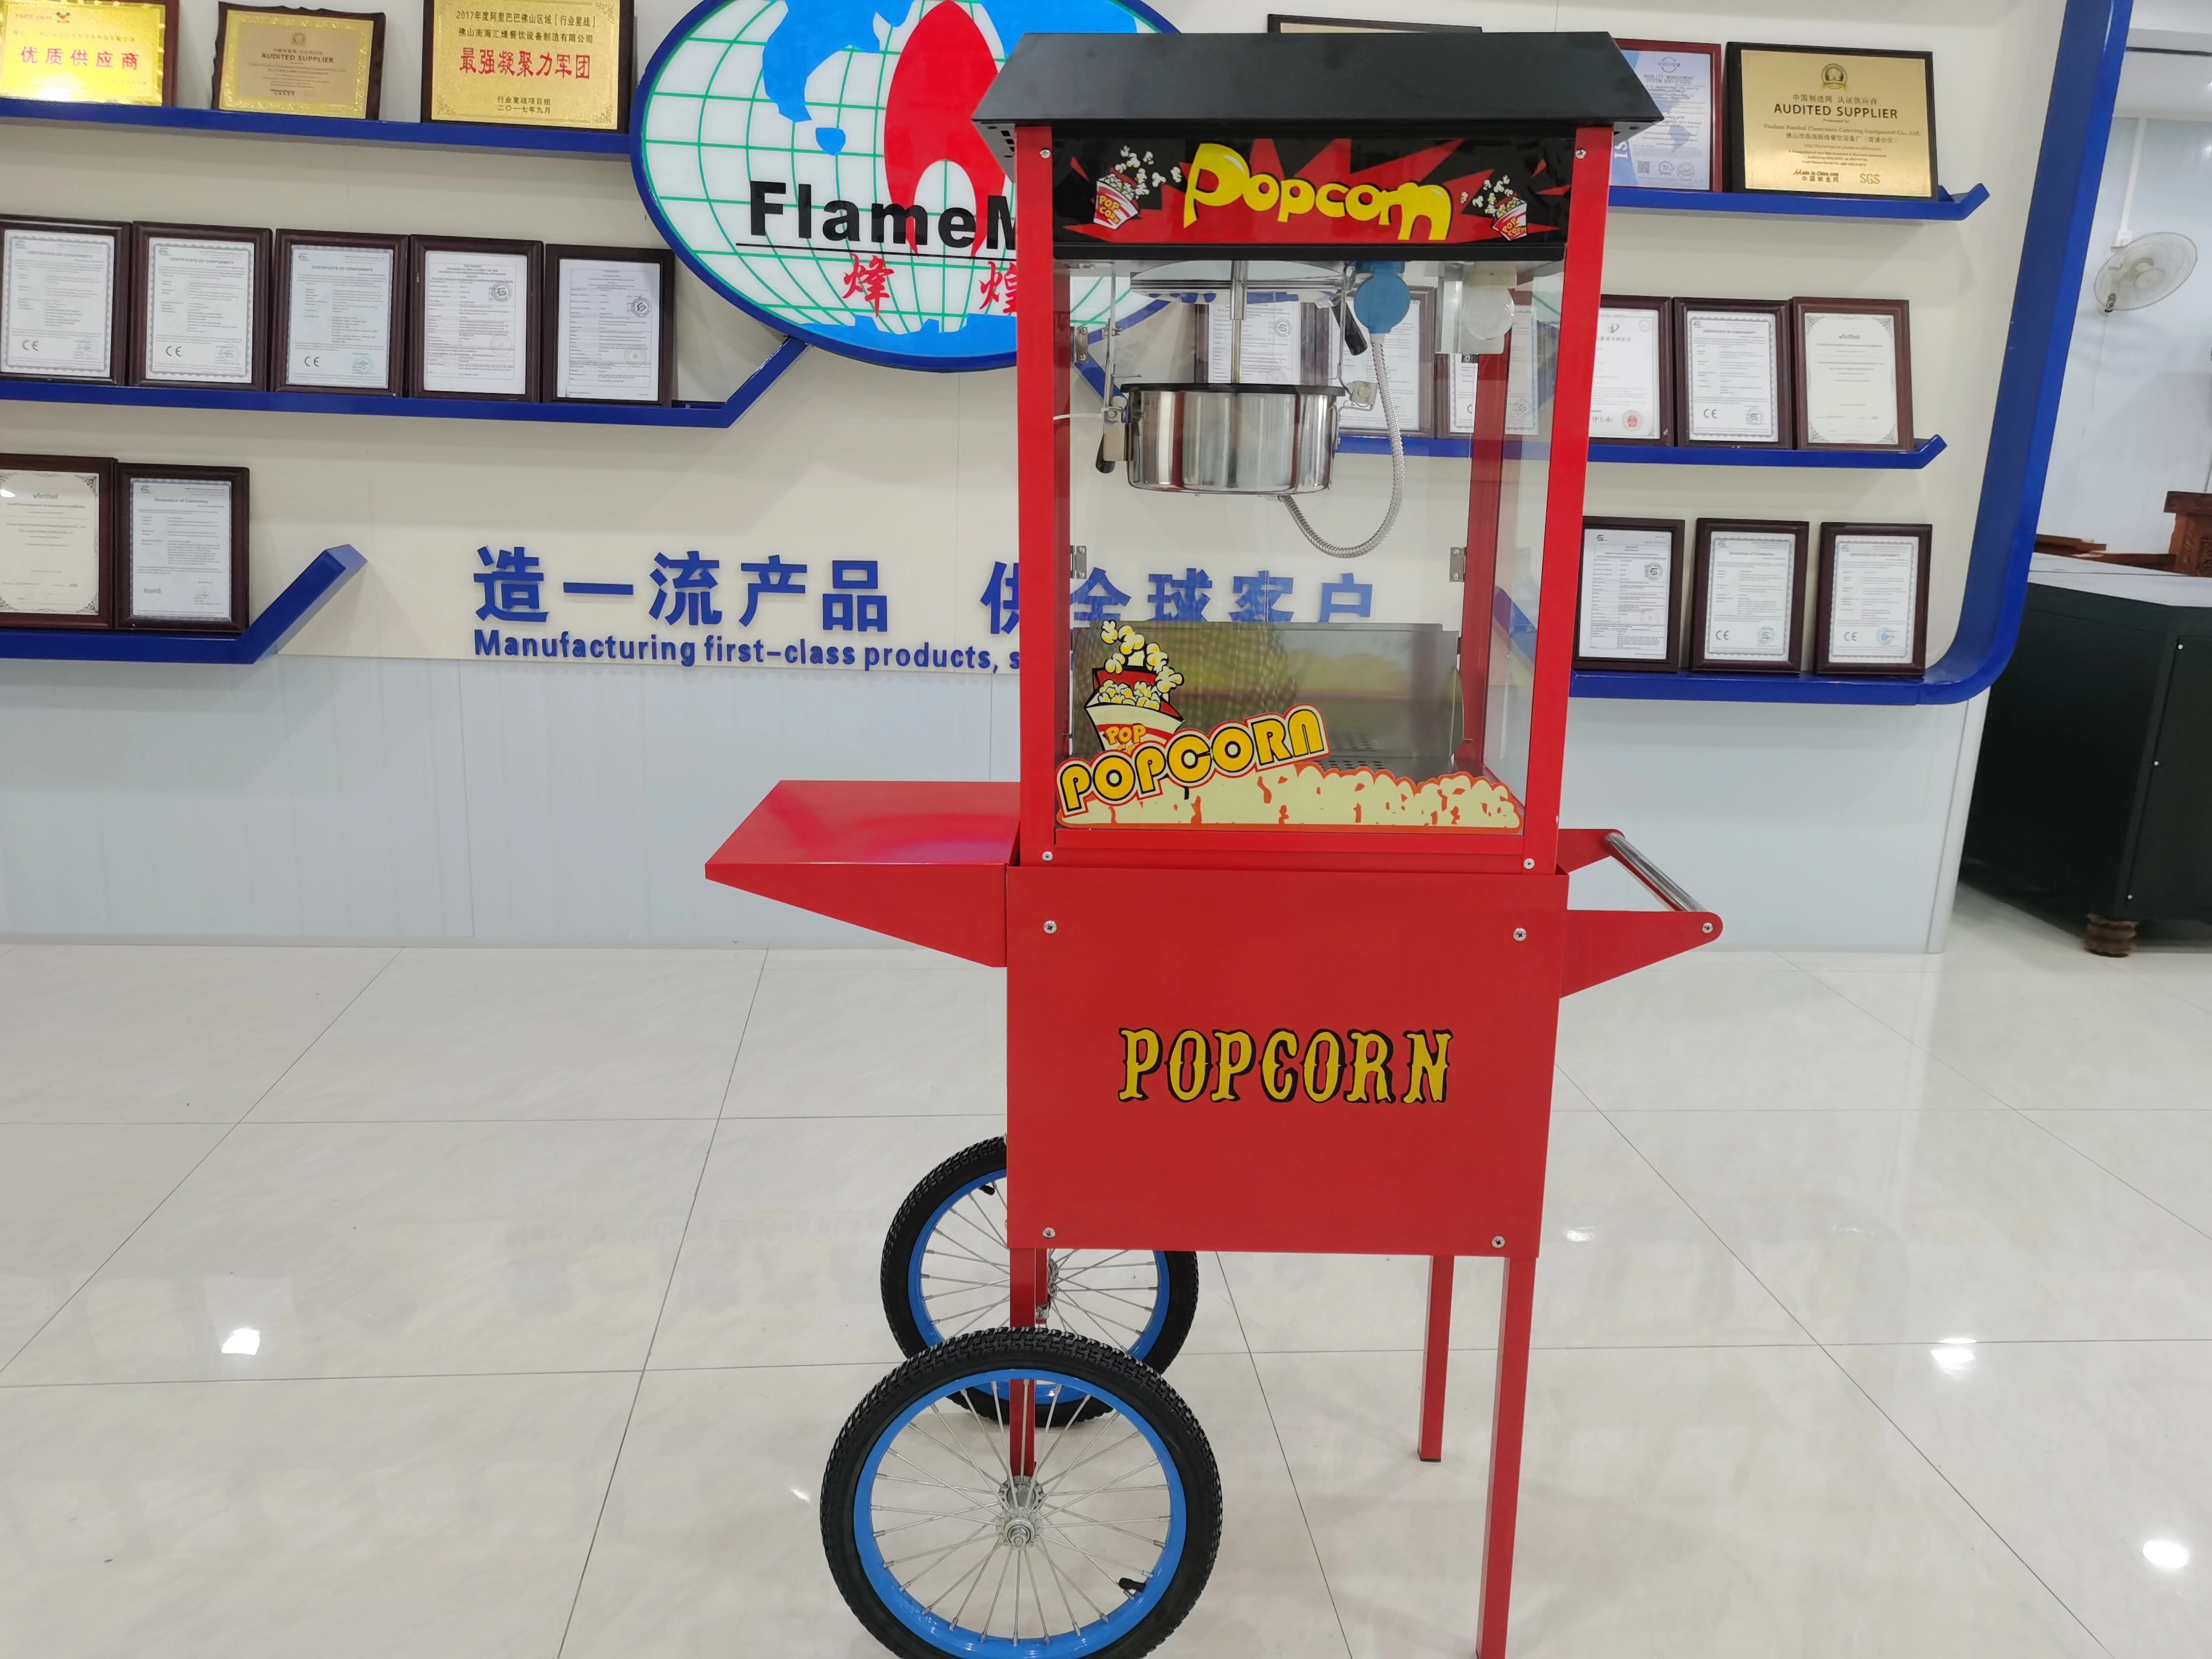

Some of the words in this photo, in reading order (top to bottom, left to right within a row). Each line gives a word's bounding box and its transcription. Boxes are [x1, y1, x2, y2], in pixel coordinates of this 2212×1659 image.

[21, 46, 139, 70] 优质供应商
[459, 47, 591, 79] 最强凝聚力军团
[497, 96, 551, 106] 行业星战项目组
[1774, 103, 1831, 115] AUDITED
[1837, 106, 1897, 119] SUPPLIER
[1859, 173, 1881, 184] SGS
[1099, 195, 1121, 211] POP
[749, 181, 1016, 250] FlameM
[1502, 217, 1517, 233] POP
[22, 339, 40, 352] CE
[166, 345, 183, 357] CE
[304, 356, 320, 367] CE
[1703, 408, 1718, 419] CE
[474, 546, 888, 632] 造一流产品
[1715, 629, 1730, 641] CE
[1844, 631, 1857, 642] CE
[474, 629, 696, 667] Manufacturing
[703, 635, 856, 666] first-class
[863, 642, 999, 675] products,
[1102, 723, 1147, 746] POP
[1059, 706, 1327, 814] POPCORN
[1118, 1027, 1455, 1104] POPCORN
